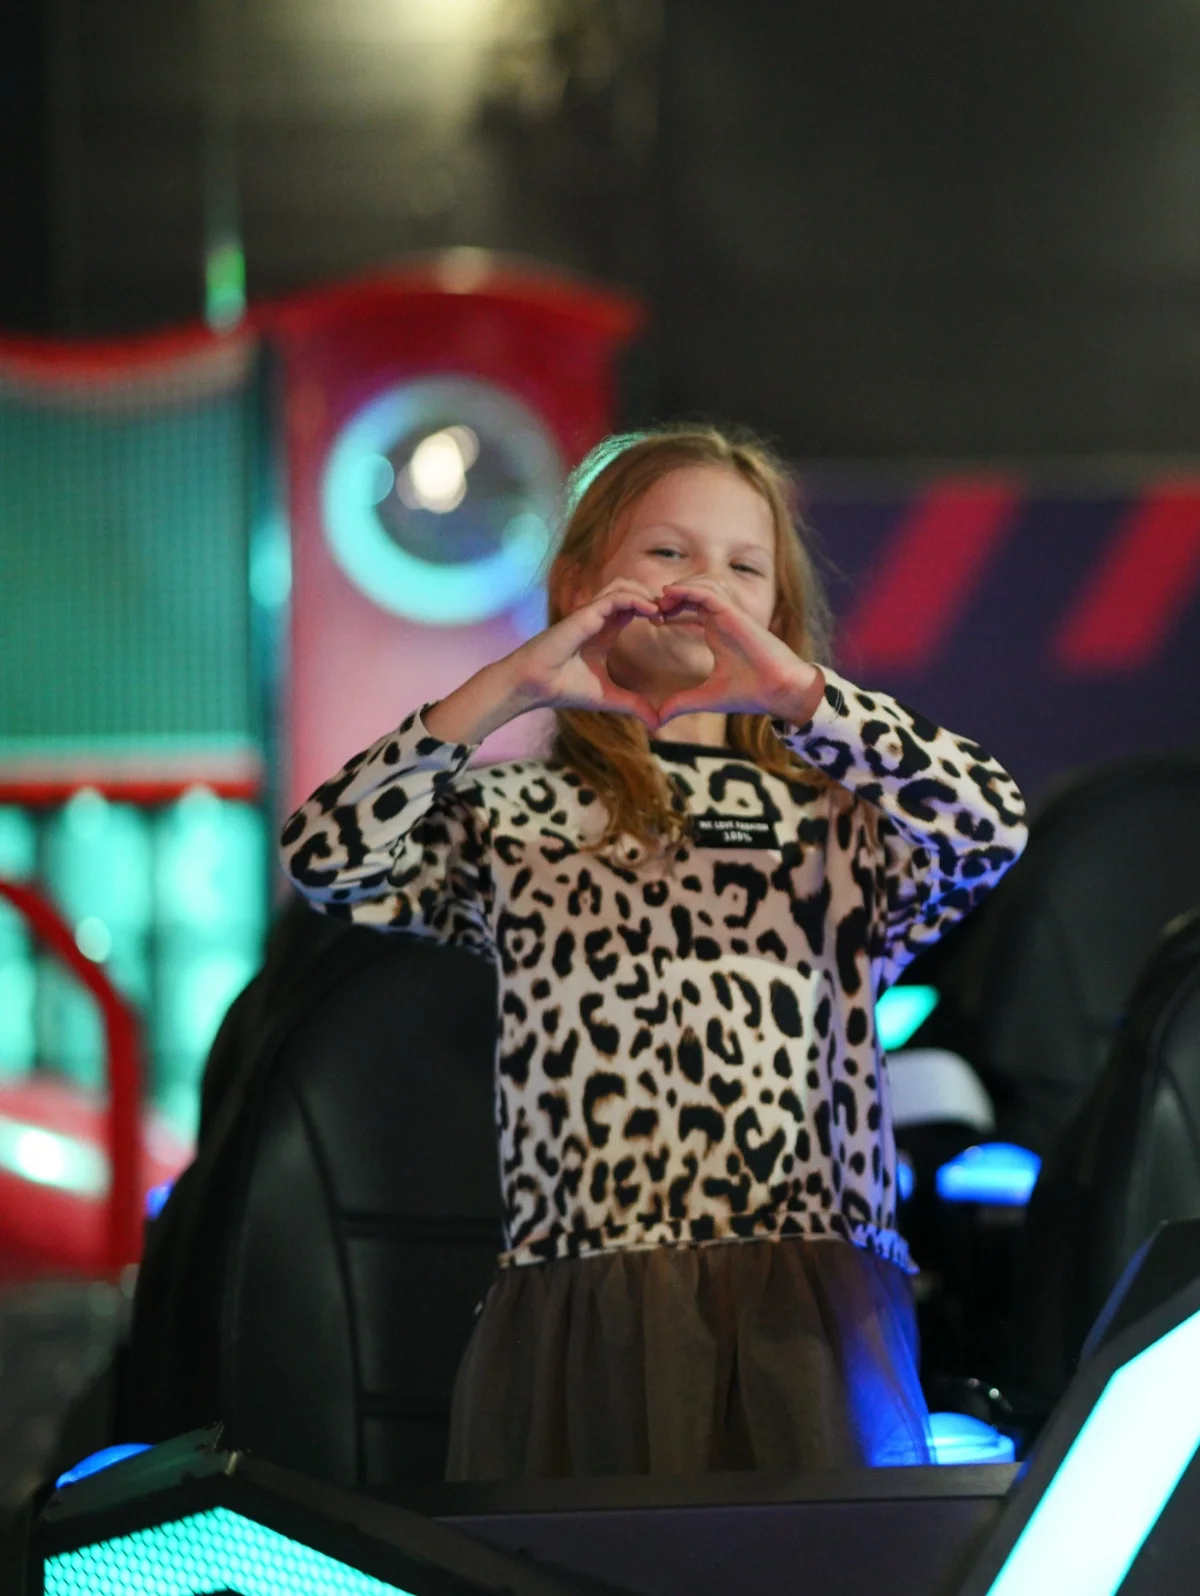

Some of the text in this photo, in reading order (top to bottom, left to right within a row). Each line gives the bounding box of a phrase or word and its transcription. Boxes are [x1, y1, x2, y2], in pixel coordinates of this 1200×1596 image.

[699, 820, 769, 832] WE LOVE FASHION
[723, 830, 753, 842] 100%
